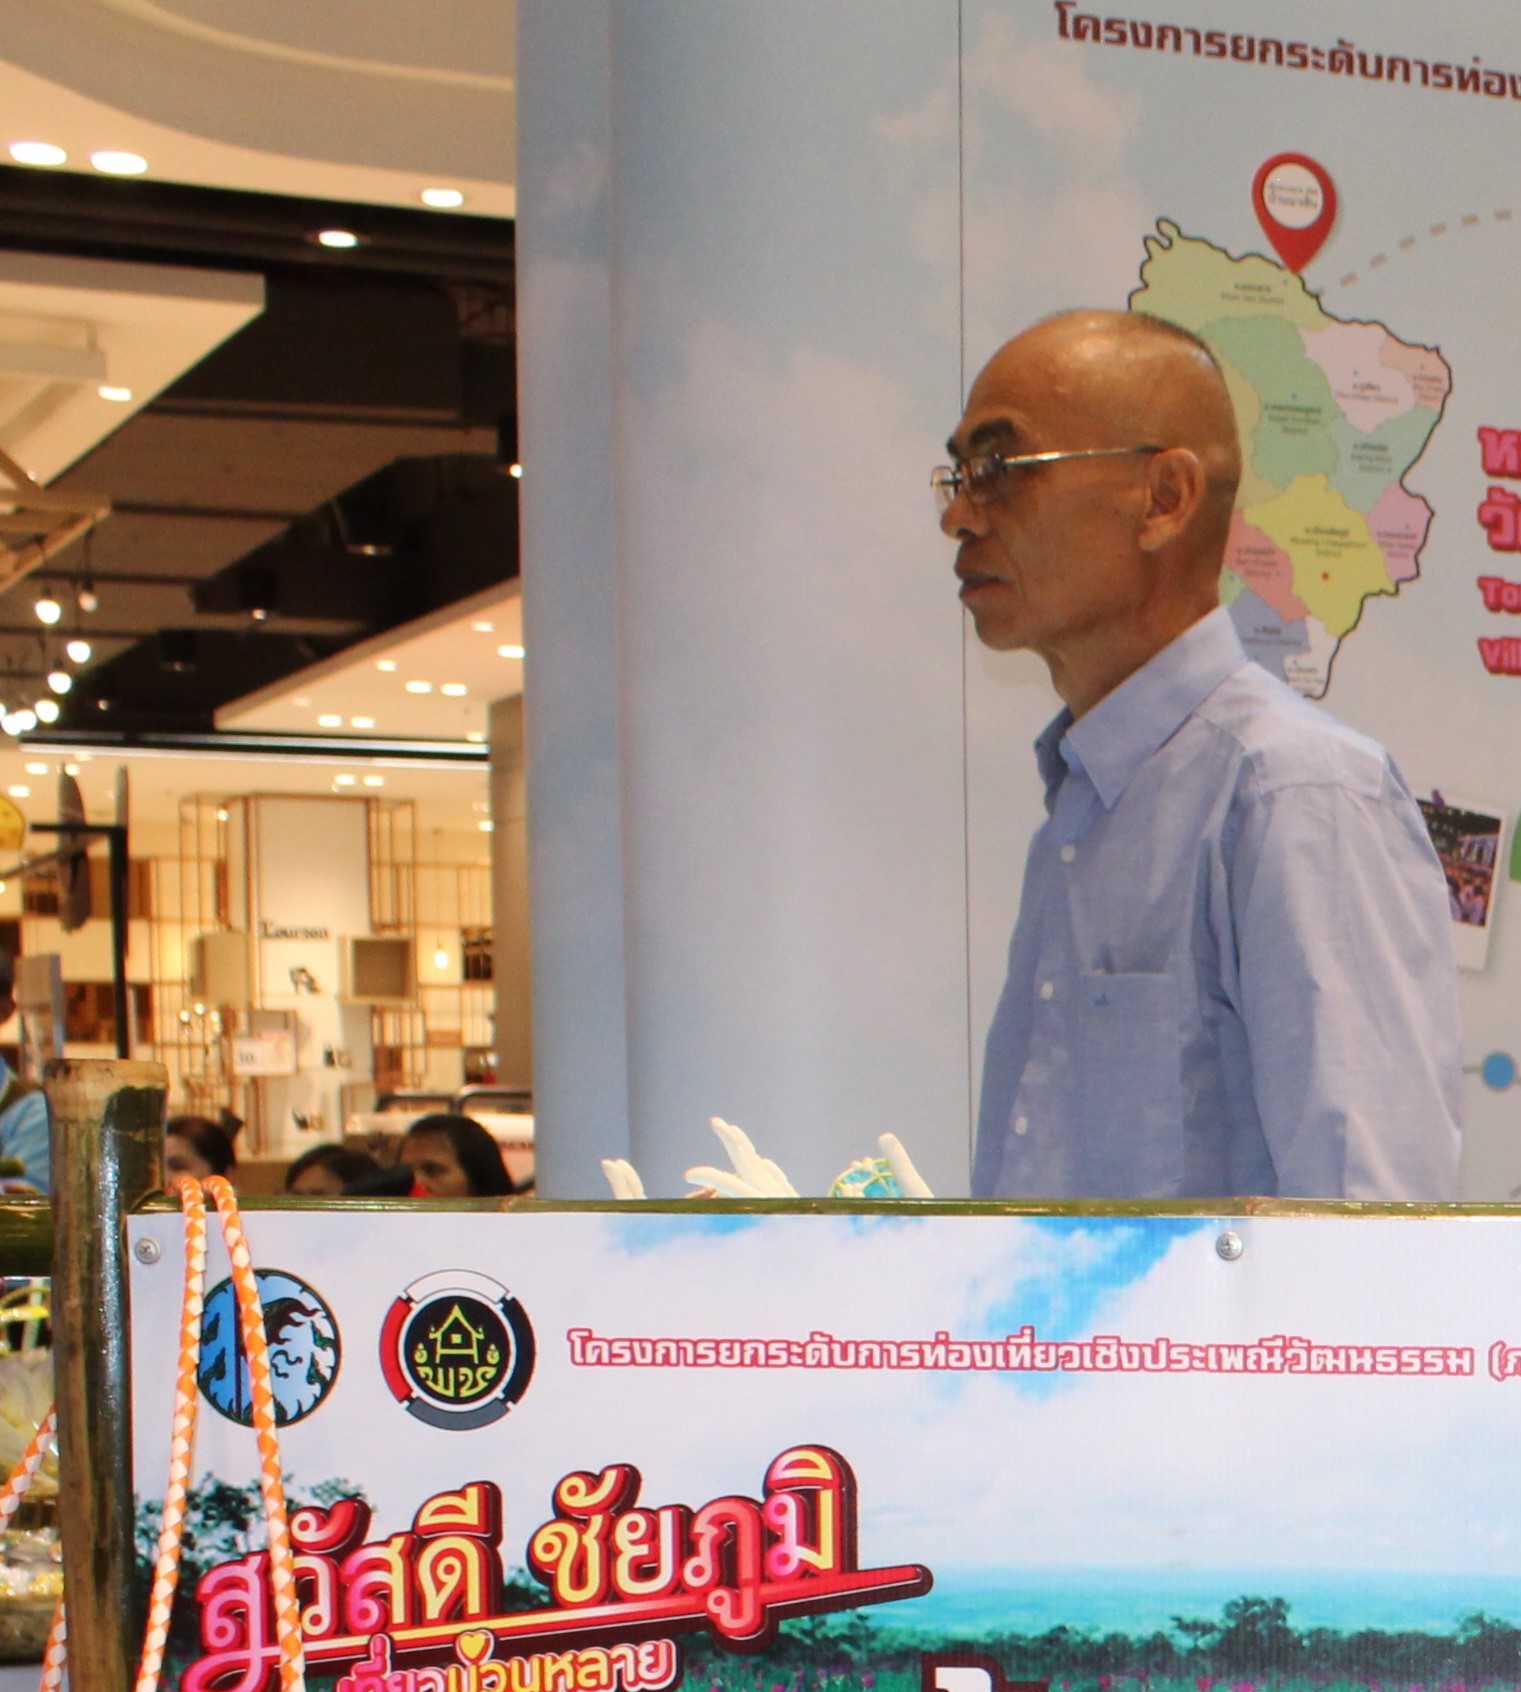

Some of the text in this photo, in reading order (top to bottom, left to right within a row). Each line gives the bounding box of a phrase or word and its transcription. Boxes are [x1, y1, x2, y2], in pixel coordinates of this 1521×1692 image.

[567, 1325, 1476, 1376] โครงการยกระดับการท่องเที่ยวเชิงประเพณีวัฒนธรรม
[530, 1444, 858, 1653] ชัยภูมิ
